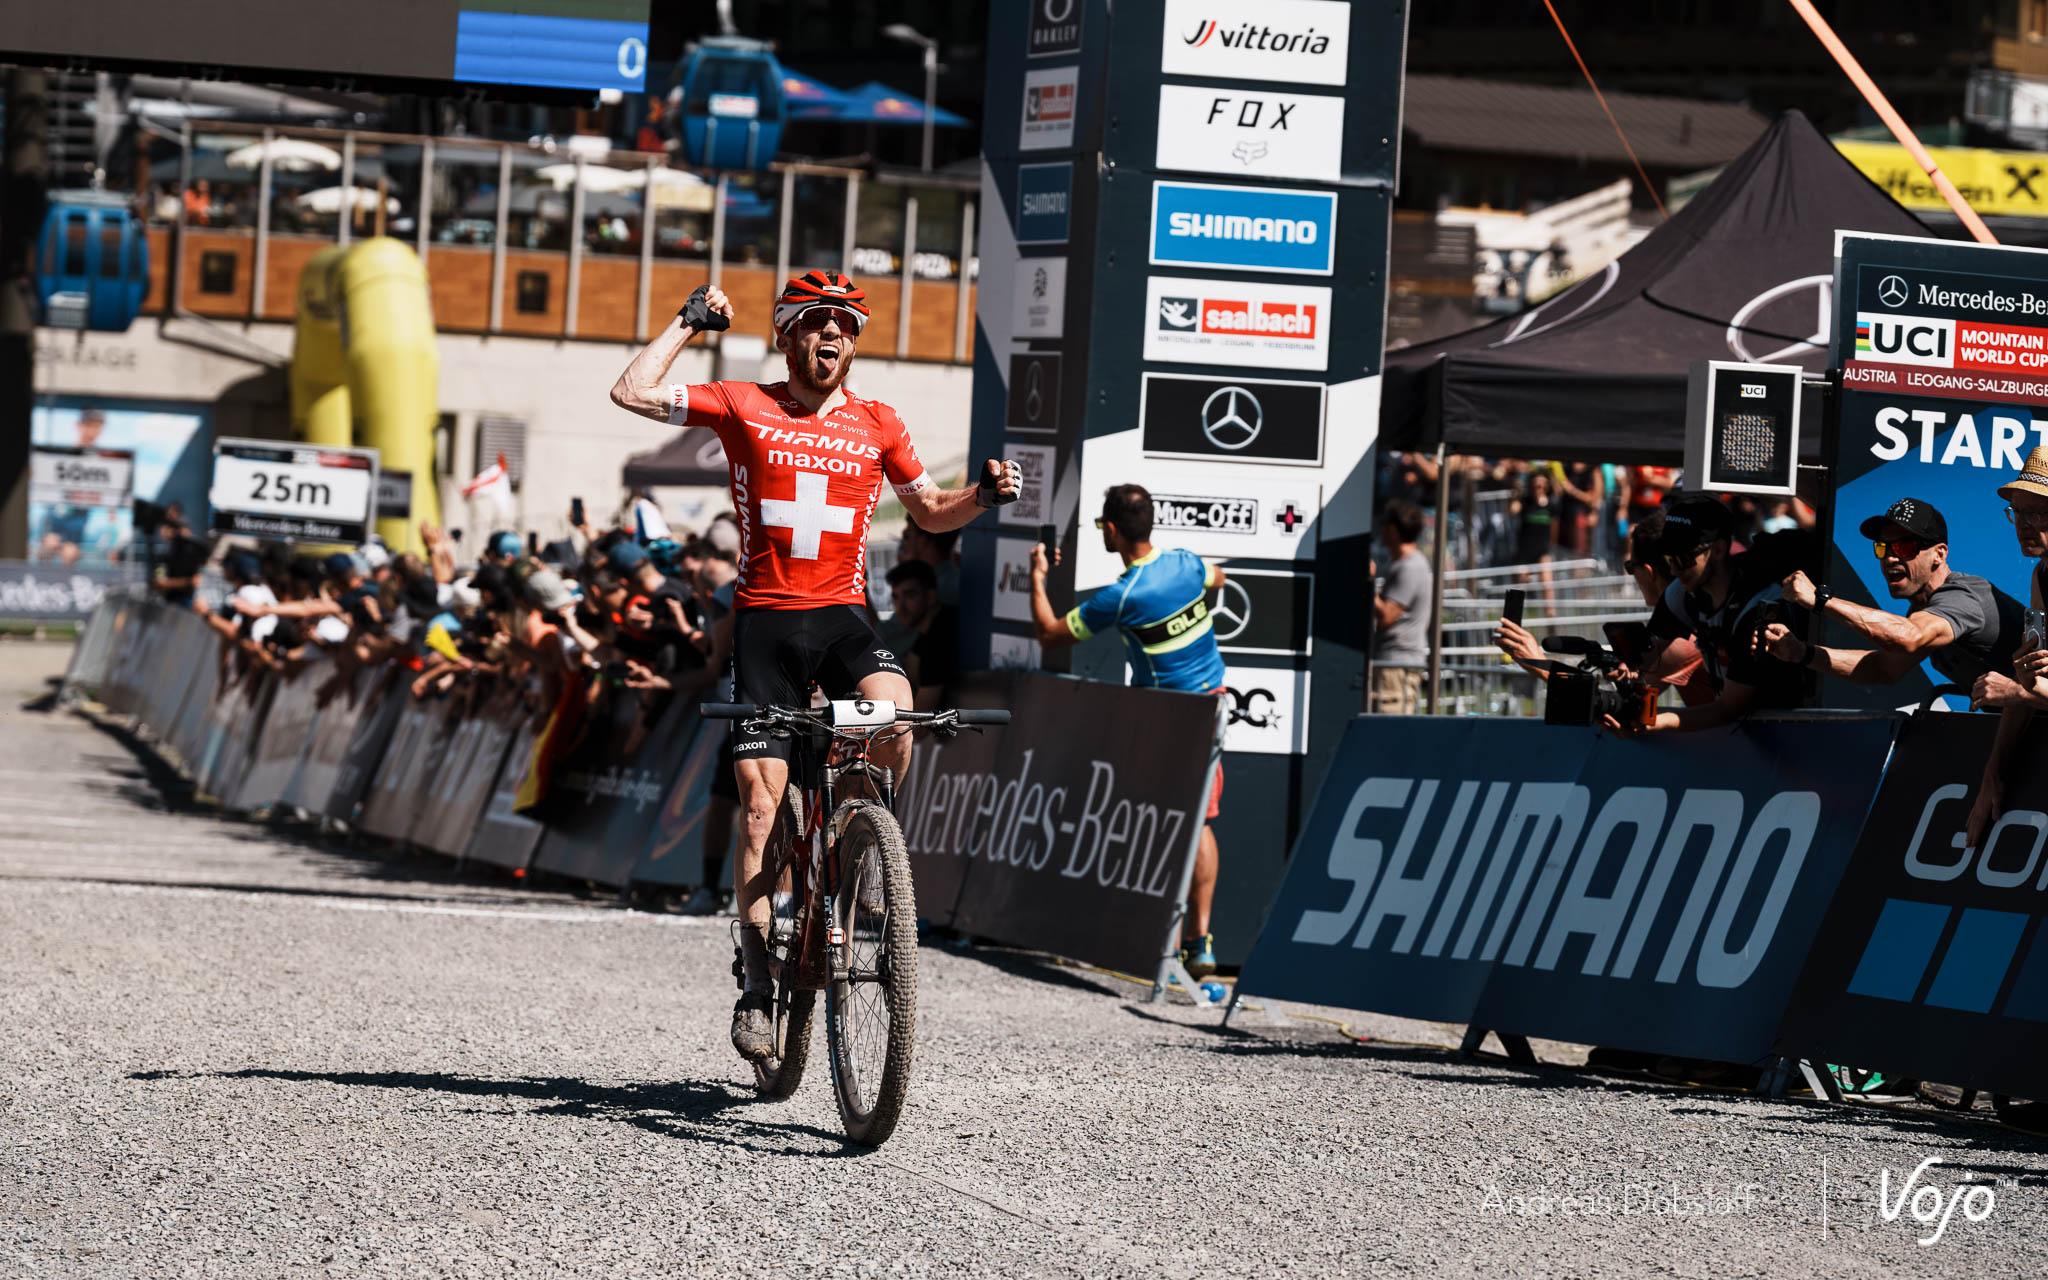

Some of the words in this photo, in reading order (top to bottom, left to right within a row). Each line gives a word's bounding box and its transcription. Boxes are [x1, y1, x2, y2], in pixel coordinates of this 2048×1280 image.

[1220, 23, 1330, 54] vittoria
[1207, 98, 1296, 130] FOX
[1022, 192, 1067, 216] SHIMANO
[1169, 212, 1317, 245] SHIMANO
[1918, 284, 2048, 317] Mercedes-Be
[1206, 302, 1311, 335] saalbach
[1874, 322, 1947, 358] UCI
[1961, 329, 2044, 350] MOUNTAIN
[1960, 346, 2016, 366] WORLD
[1843, 367, 1897, 384] AUSTRIA
[1745, 387, 1764, 396] UCI
[842, 424, 868, 437] SWISS
[768, 449, 862, 477] maxon
[250, 472, 331, 505] 25m
[1153, 501, 1251, 530] Muc-Off
[904, 743, 1186, 898] Mercedes-Benz
[1904, 783, 2048, 891] Go
[1292, 777, 1821, 988] SHIMANO
